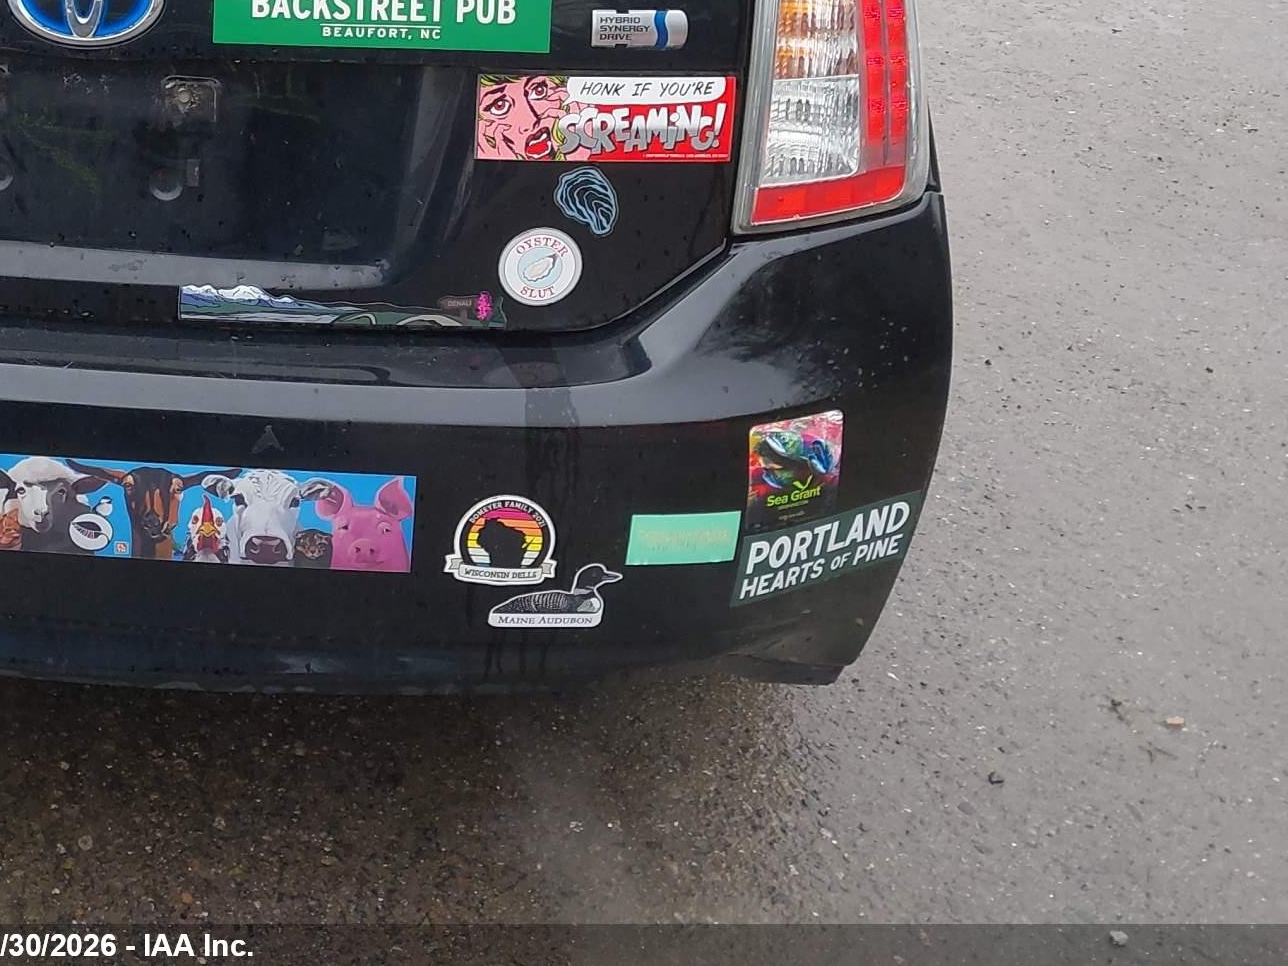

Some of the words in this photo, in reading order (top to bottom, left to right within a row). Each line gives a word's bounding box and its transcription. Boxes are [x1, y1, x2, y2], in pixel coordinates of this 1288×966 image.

[322, 26, 413, 40] BEAUFORT,
[420, 29, 442, 40] NC
[580, 82, 624, 96] HONK
[632, 83, 652, 97] IF
[661, 81, 715, 97] YOU'RE
[516, 237, 569, 257] OYSTER
[520, 285, 554, 299] SLUT
[767, 494, 789, 507] Sea
[791, 485, 821, 502] Grant
[504, 500, 533, 514] FAMILY
[745, 501, 910, 574] PORTLAND
[464, 569, 510, 579] WISCONSIN
[512, 571, 537, 579] DELLS
[739, 560, 825, 600] HEARTS
[830, 552, 849, 571] OF
[852, 534, 903, 567] PINE
[498, 616, 535, 625] MAINE
[538, 616, 593, 624] AUDUBON
